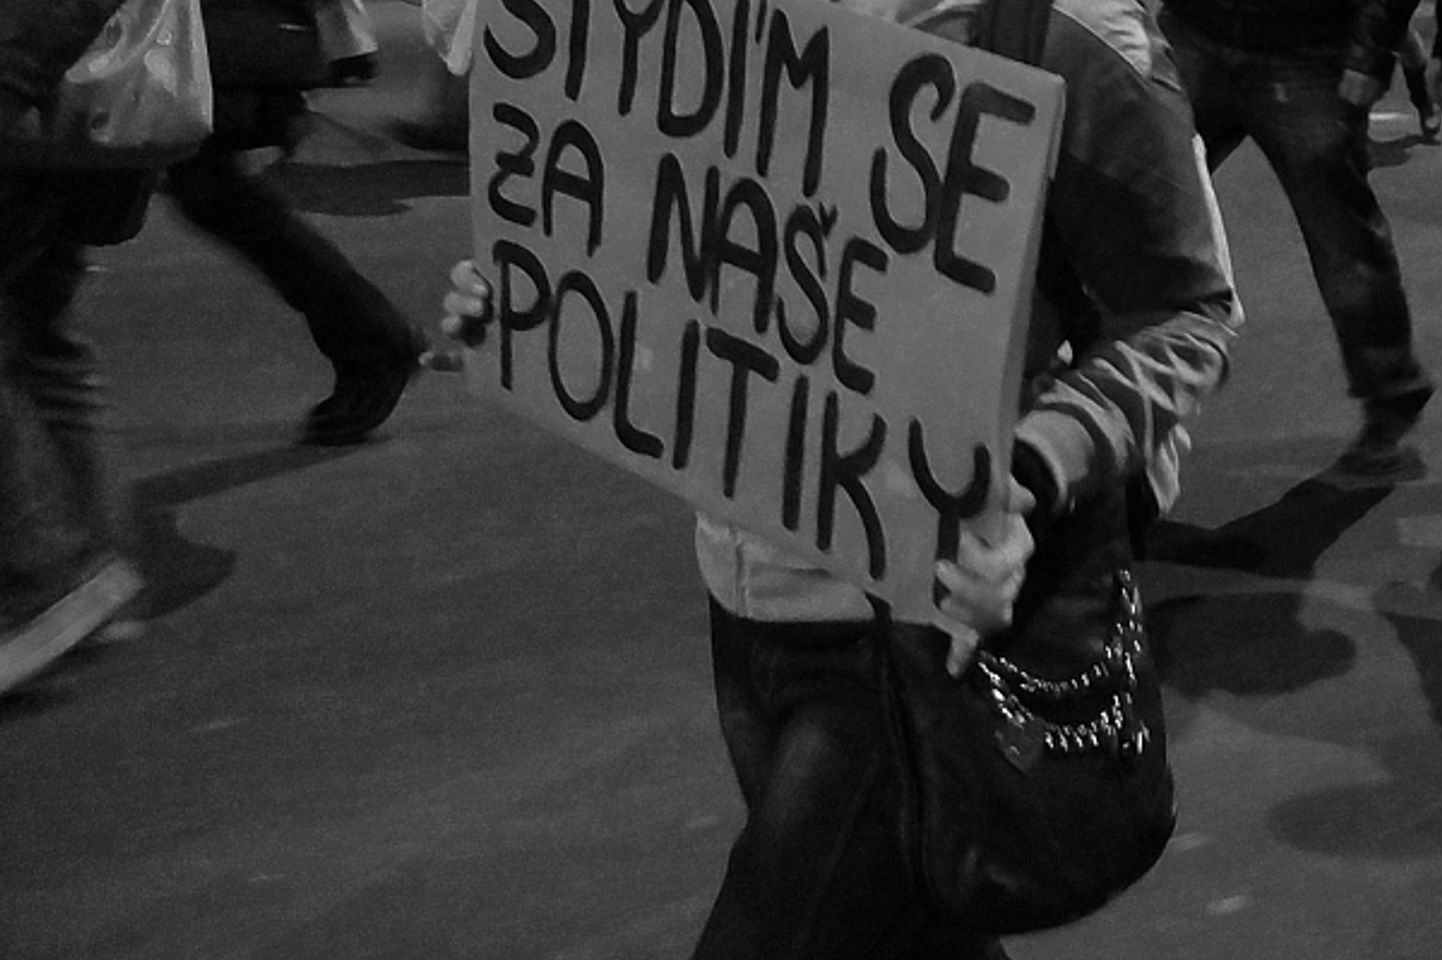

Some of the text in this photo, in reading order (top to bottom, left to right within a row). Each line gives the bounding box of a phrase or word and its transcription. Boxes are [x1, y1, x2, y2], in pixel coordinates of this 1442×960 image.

[487, 102, 889, 396] ZA NAŠE
[870, 52, 1036, 293] SE
[492, 240, 992, 608] POLITIKY
